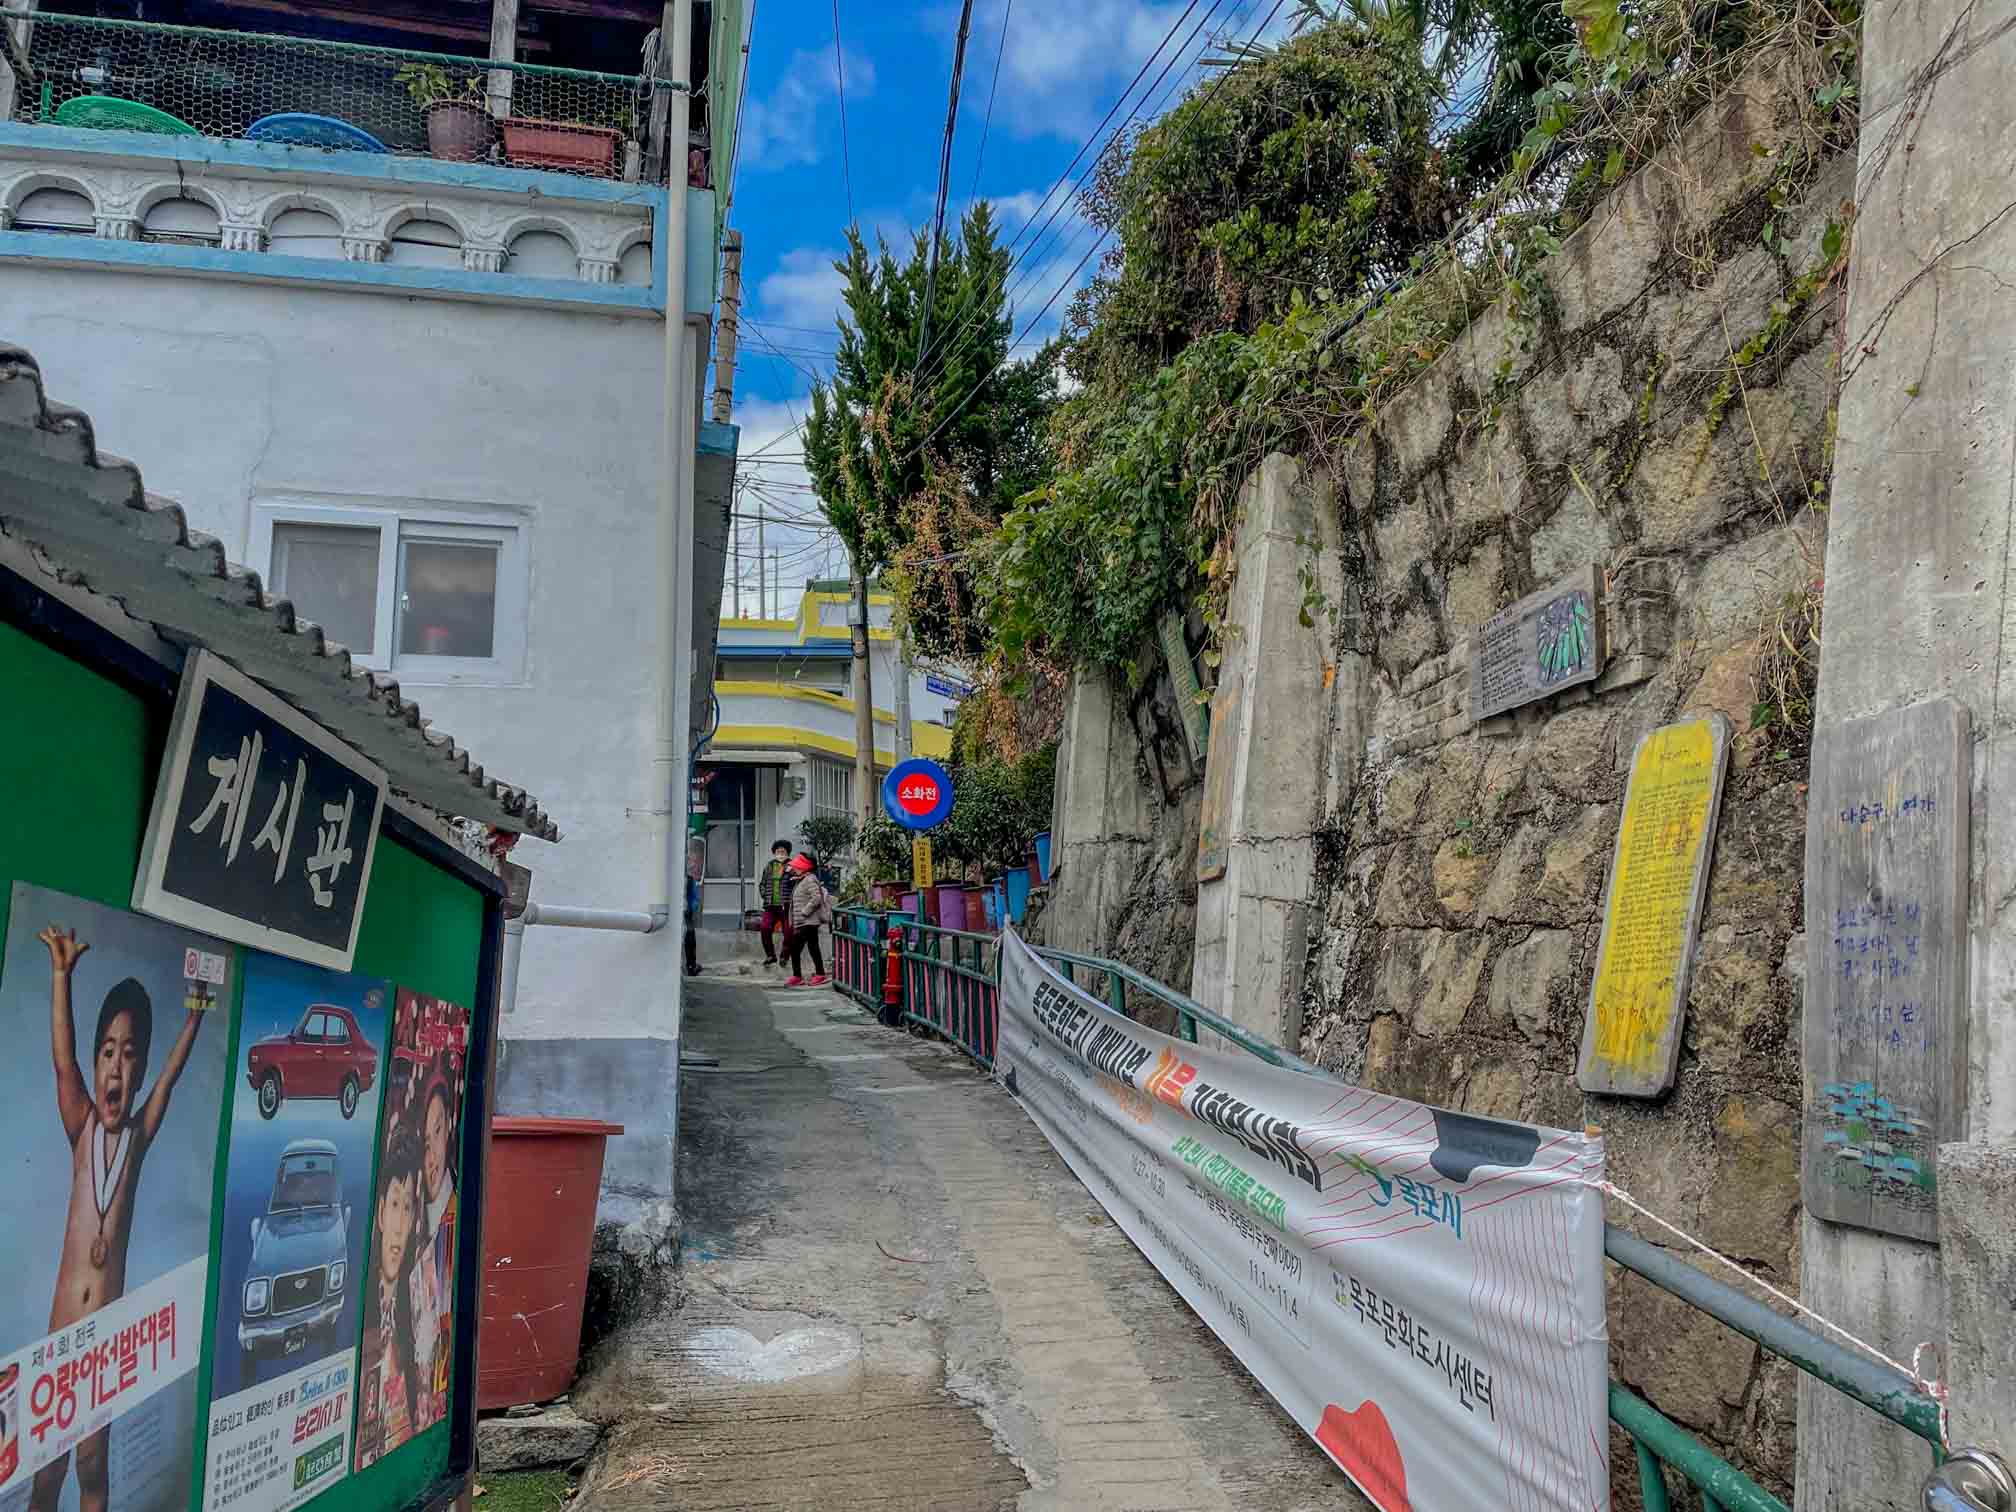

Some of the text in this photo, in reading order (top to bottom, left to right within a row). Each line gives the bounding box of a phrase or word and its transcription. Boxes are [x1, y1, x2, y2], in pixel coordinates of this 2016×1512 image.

[189, 730, 353, 908] 게시판
[902, 786, 936, 801] 소화전
[1393, 1174, 1461, 1240] 목포시
[31, 1301, 176, 1443] 우량아선발대회
[1350, 1276, 1495, 1422] 목포문화도시센터
